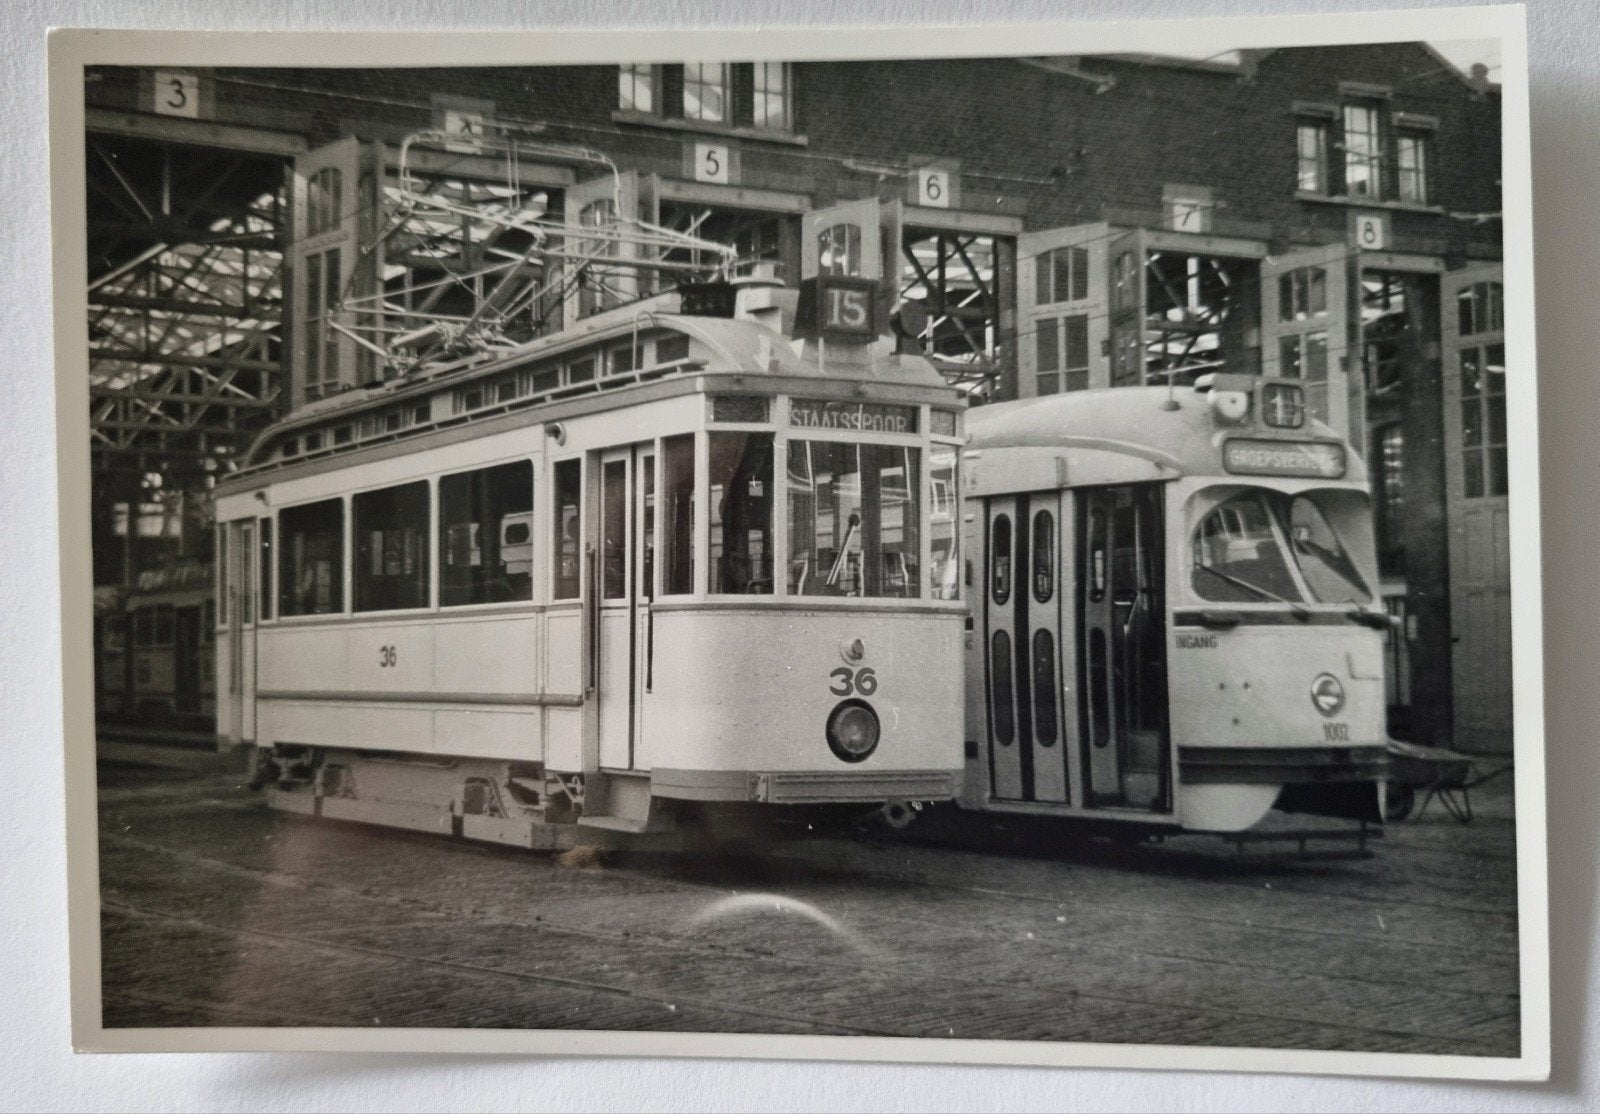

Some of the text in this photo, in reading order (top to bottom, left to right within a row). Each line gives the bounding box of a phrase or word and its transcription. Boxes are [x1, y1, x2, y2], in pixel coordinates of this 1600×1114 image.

[166, 79, 187, 109] 3
[706, 150, 719, 176] 5
[926, 174, 941, 200] 6
[1181, 203, 1199, 227] 7
[1363, 221, 1376, 244] 8
[826, 288, 866, 328] 15
[791, 408, 907, 432] STAATSSPOOR
[380, 645, 397, 668] 36
[829, 666, 878, 697] 36
